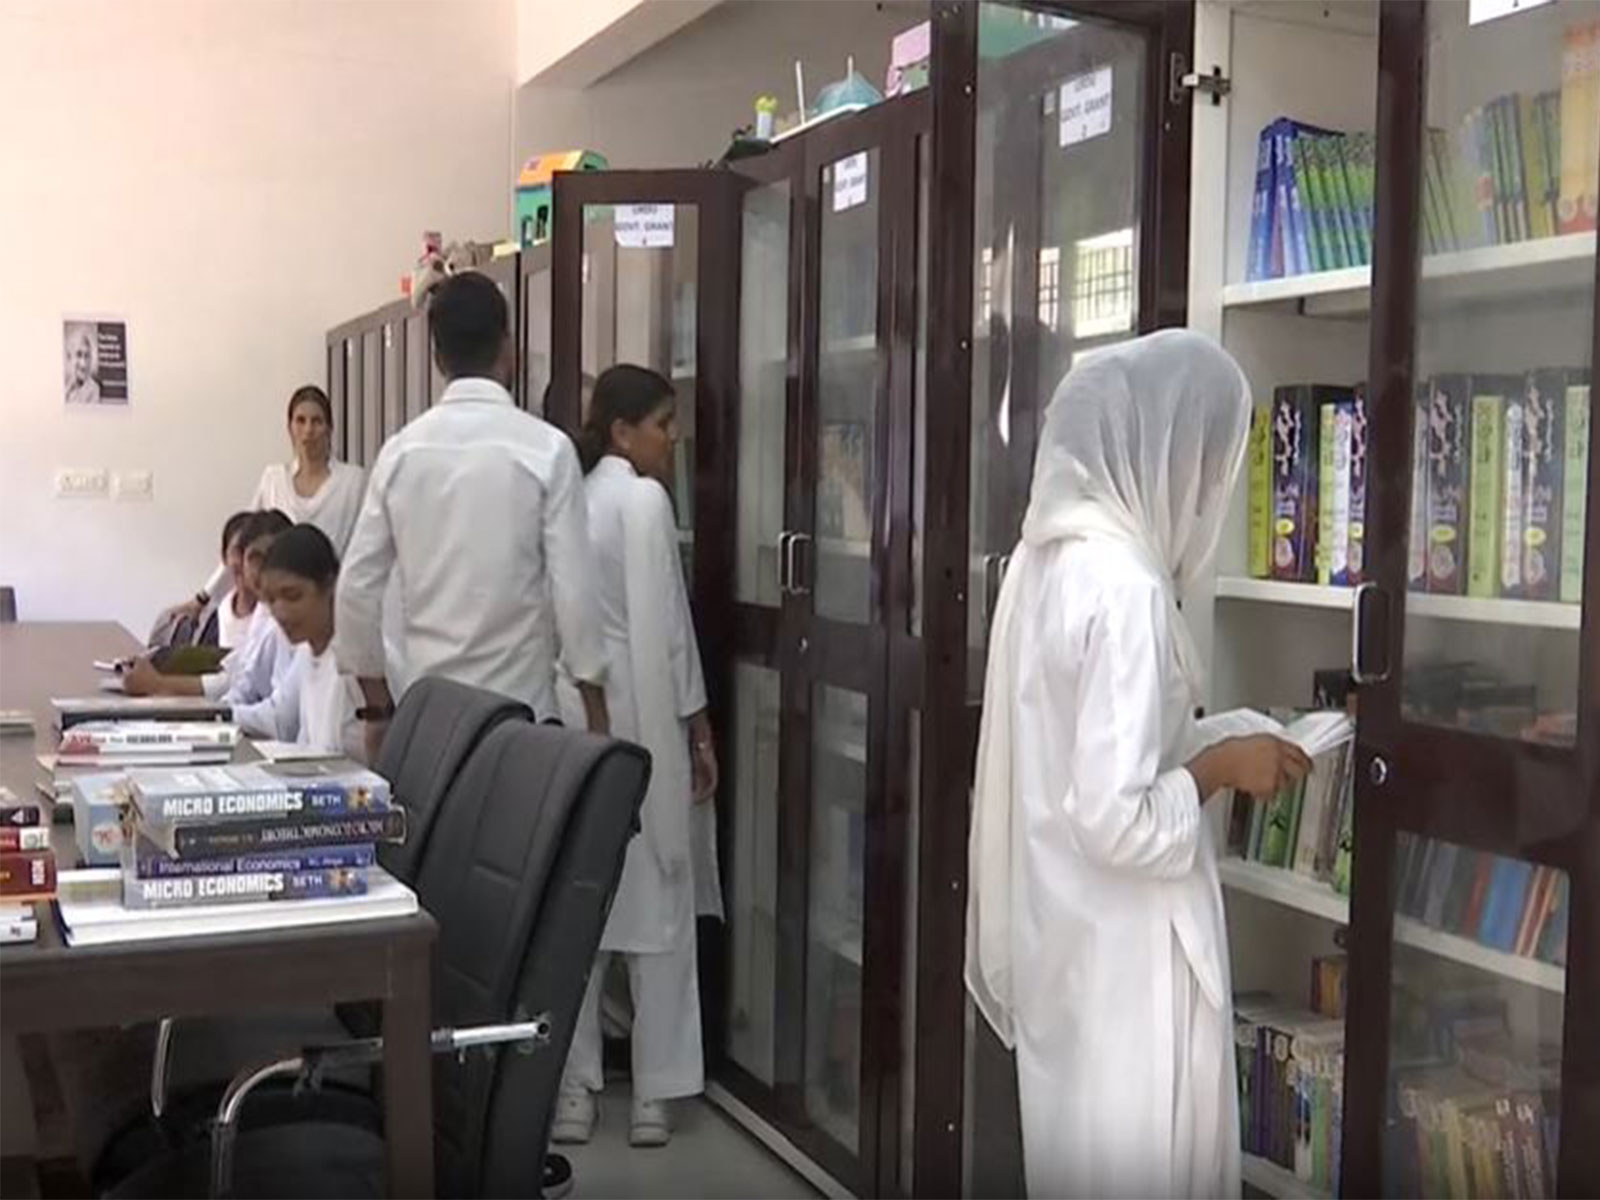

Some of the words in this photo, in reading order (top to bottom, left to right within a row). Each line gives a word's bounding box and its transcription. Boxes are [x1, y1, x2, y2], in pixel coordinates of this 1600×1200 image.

[163, 797, 213, 817] MICRO
[217, 792, 303, 815] ECONOMICS
[236, 857, 301, 872] Economics
[143, 877, 193, 900] MICRO
[198, 873, 284, 897] ECONOMICS
